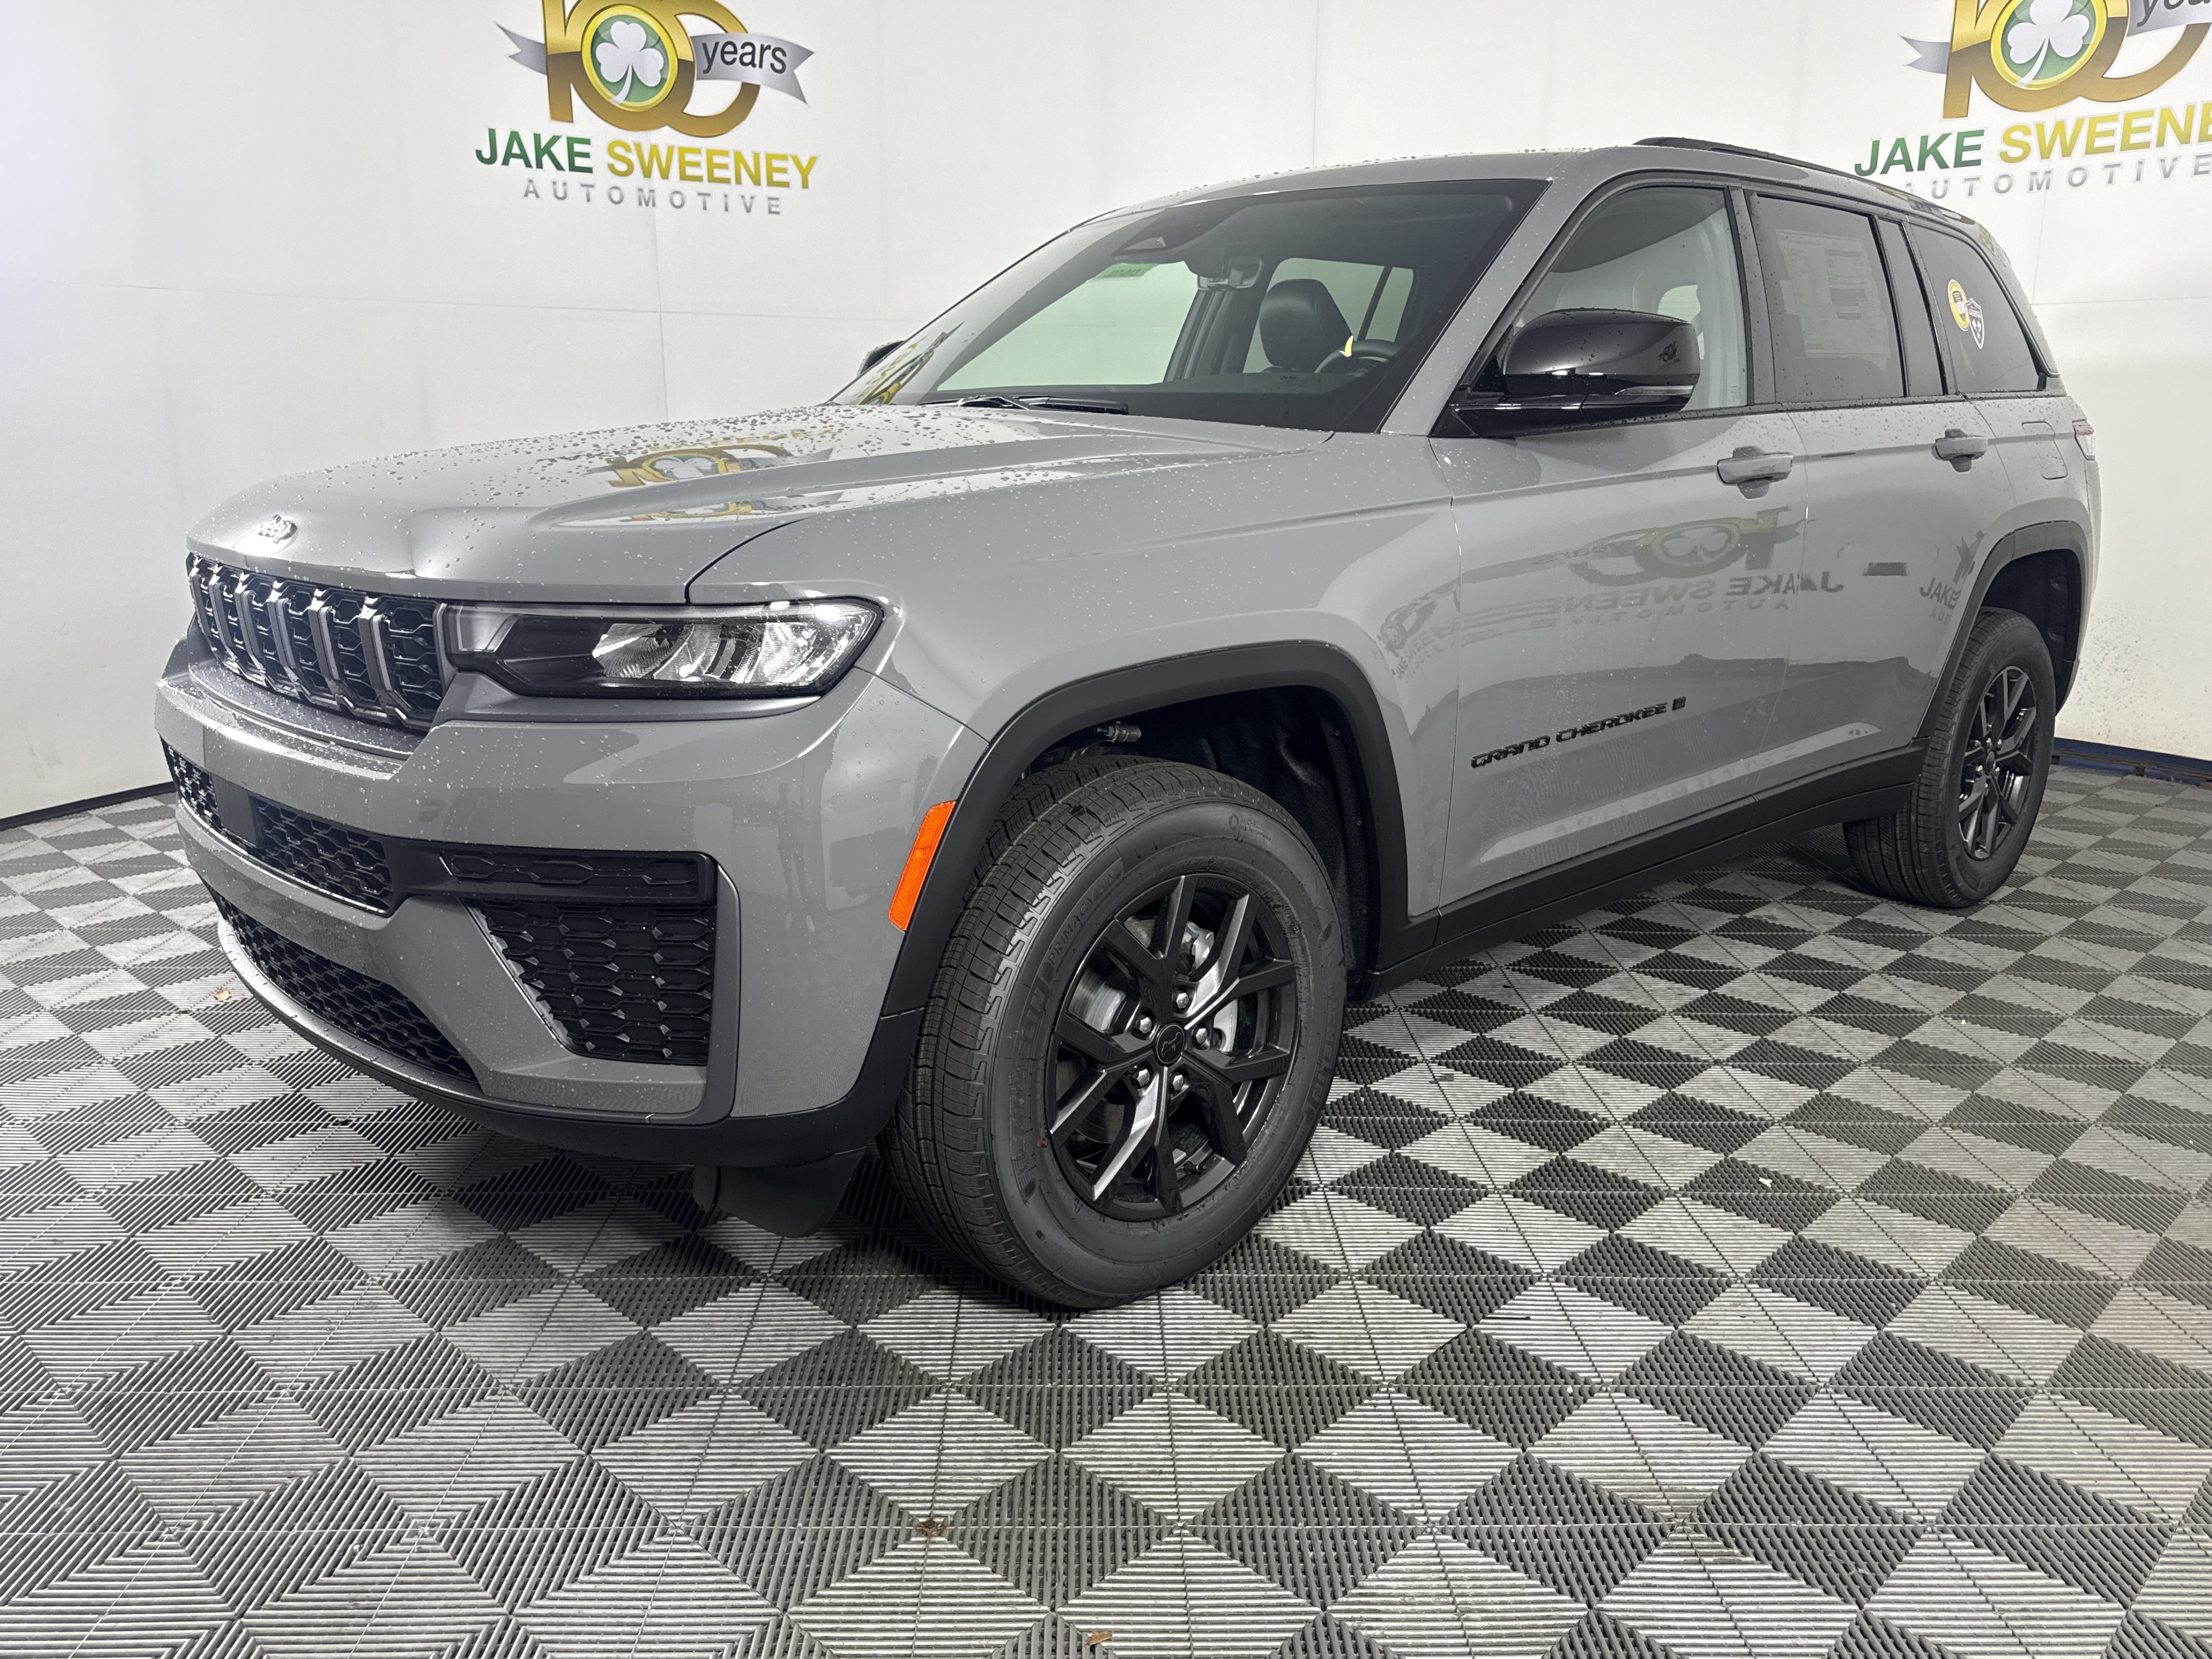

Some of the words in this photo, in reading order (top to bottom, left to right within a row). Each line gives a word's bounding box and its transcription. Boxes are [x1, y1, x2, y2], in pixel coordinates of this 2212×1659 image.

[702, 41, 788, 74] years
[476, 128, 593, 173] JAKE
[607, 140, 818, 189] SWEENEY
[1854, 129, 1985, 176] JAKE
[524, 179, 781, 215] AUTOMOTIVE
[1471, 735, 1550, 768] GRAND
[1556, 702, 1668, 742] CHEROKEE
[1048, 893, 1094, 966] PRIMACY
